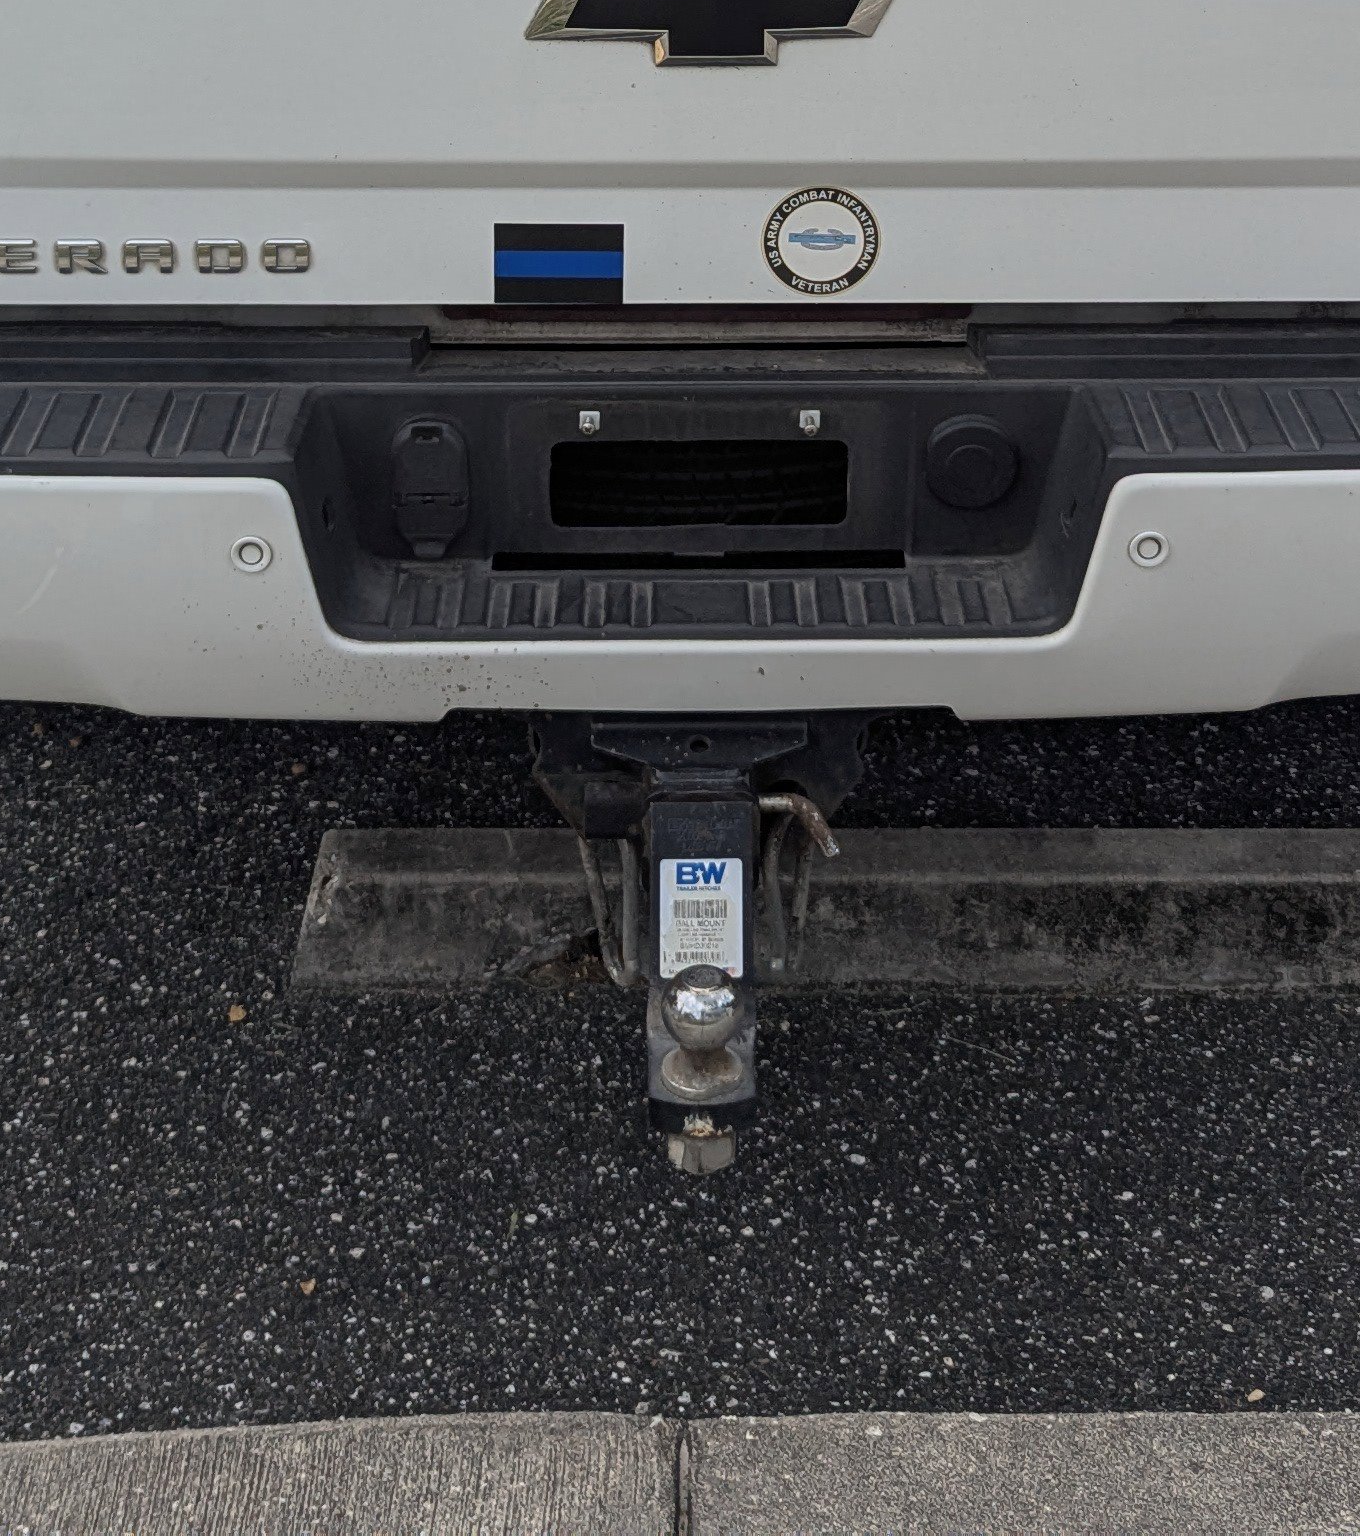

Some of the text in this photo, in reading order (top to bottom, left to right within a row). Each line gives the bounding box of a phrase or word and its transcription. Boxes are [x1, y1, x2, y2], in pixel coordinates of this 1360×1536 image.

[766, 190, 875, 270] US ARMY COMBAT INFANTRYMAN
[791, 276, 849, 293] VETERAN
